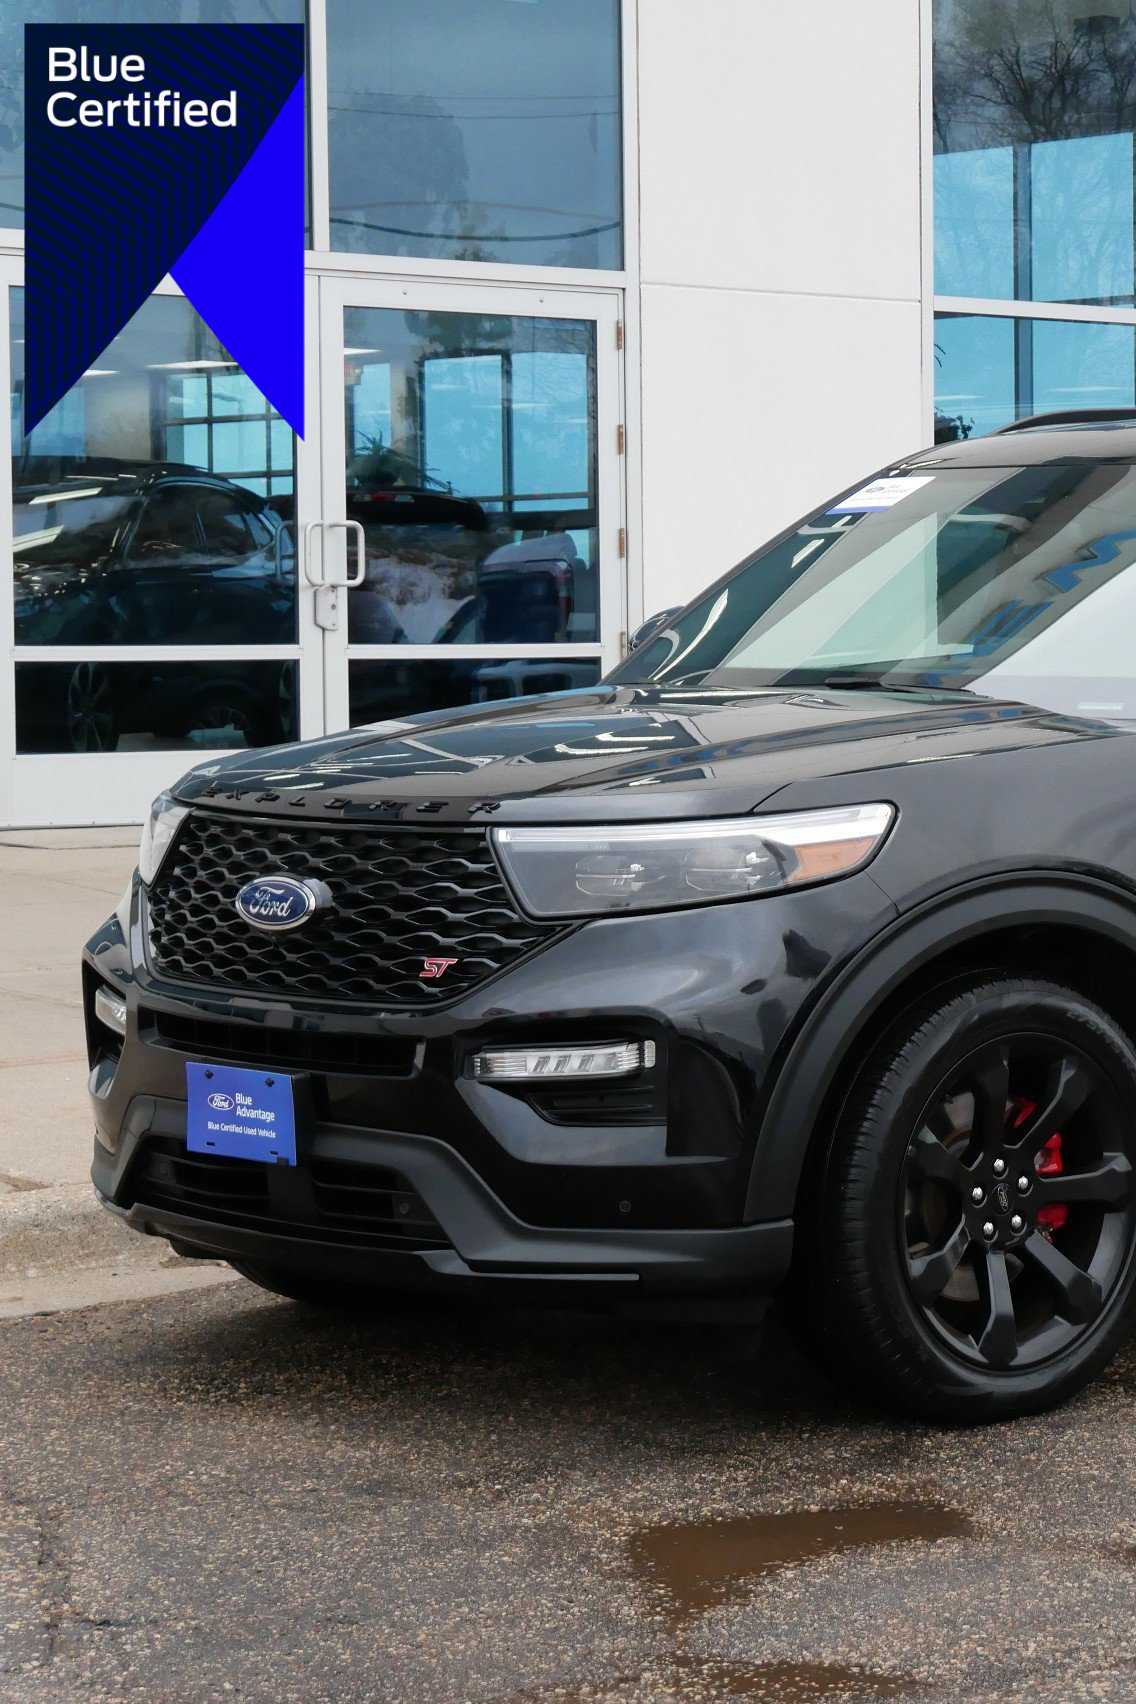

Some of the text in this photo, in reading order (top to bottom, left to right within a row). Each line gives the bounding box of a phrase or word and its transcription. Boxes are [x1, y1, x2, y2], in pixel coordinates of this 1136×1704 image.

[201, 786, 501, 813] EXPLORER
[249, 887, 292, 917] Ford
[419, 958, 457, 977] ST
[235, 1092, 252, 1105] Blue
[236, 1105, 275, 1122] Advantage
[207, 1121, 276, 1138] Blue Certified Used Vehicle
